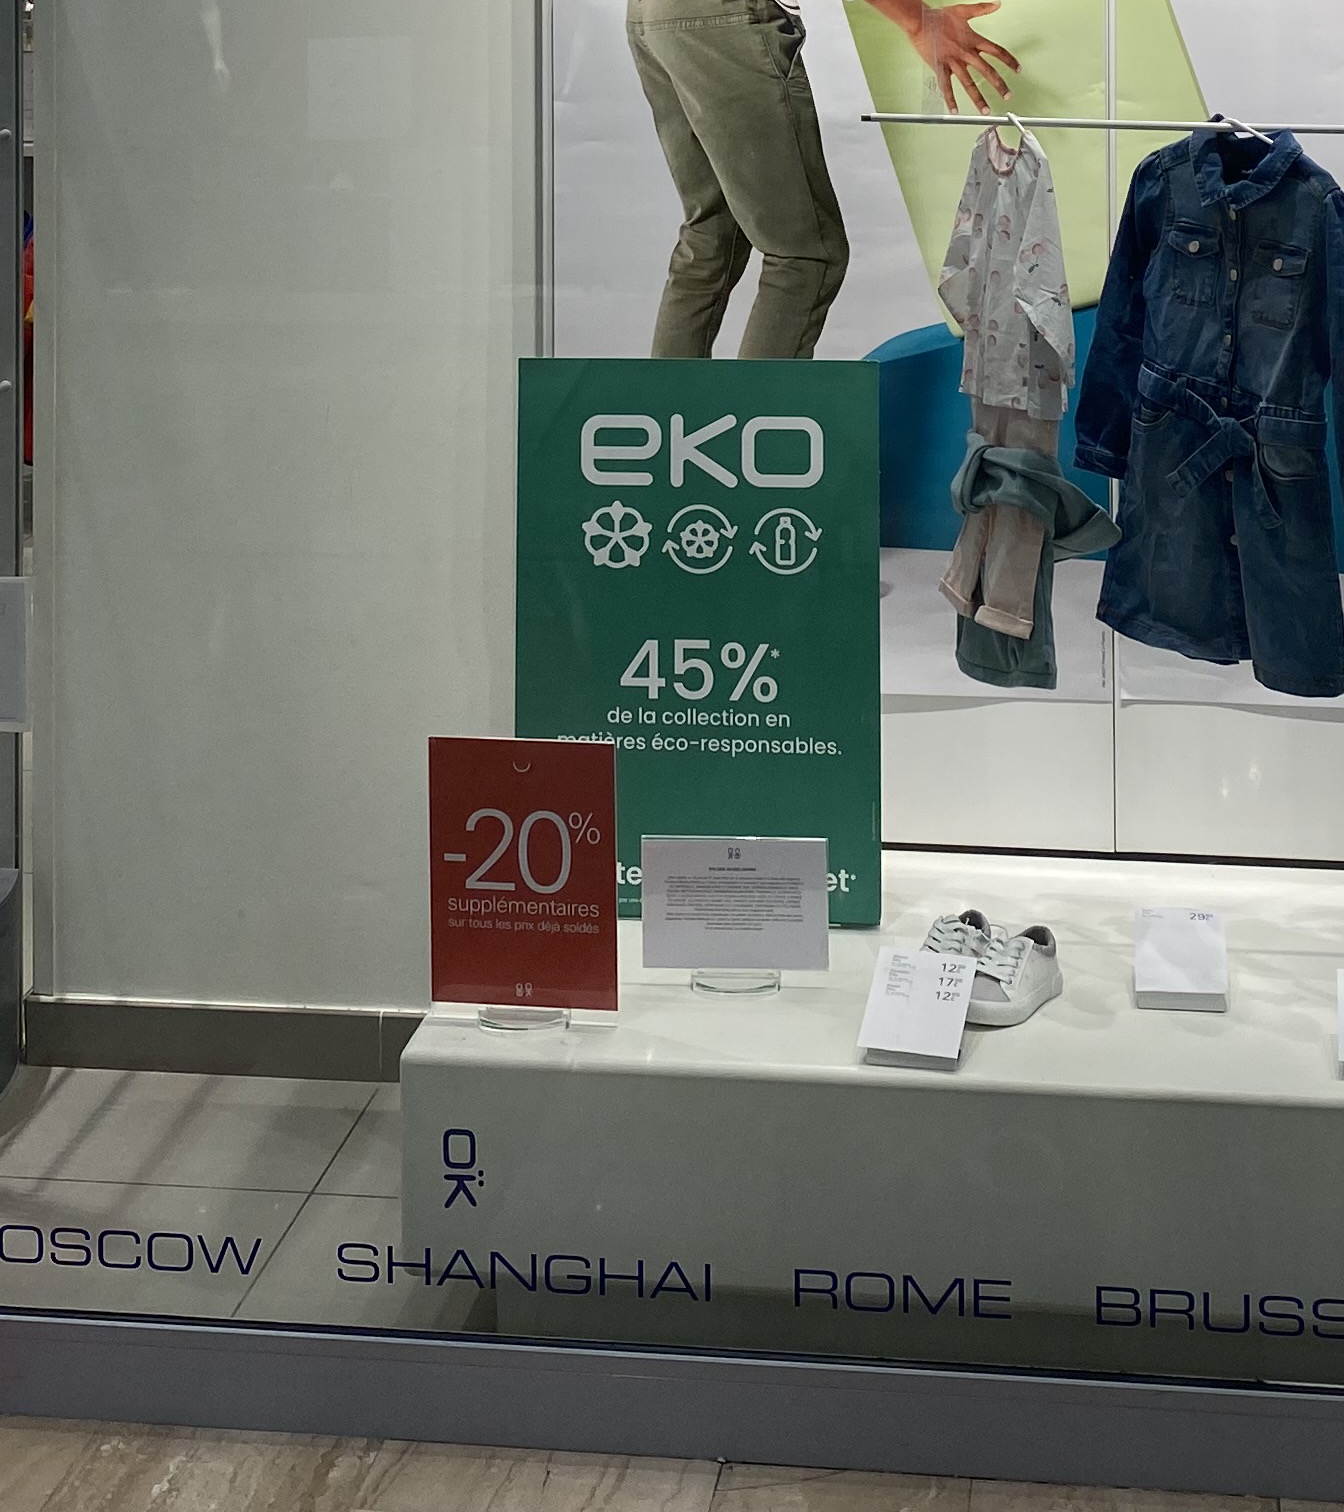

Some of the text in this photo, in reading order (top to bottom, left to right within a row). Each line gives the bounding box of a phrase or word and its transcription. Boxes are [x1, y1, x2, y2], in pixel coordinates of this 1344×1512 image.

[580, 413, 826, 488] eko
[607, 706, 791, 728] de la collection en
[651, 732, 843, 758] éco-responsables.
[443, 808, 601, 895] -20%
[447, 896, 600, 918] supplémentaires
[448, 918, 466, 928] sur
[469, 918, 493, 929] tous
[514, 920, 535, 933] prix
[335, 1242, 713, 1302] SHANGHAI
[793, 1268, 1013, 1320] ROME
